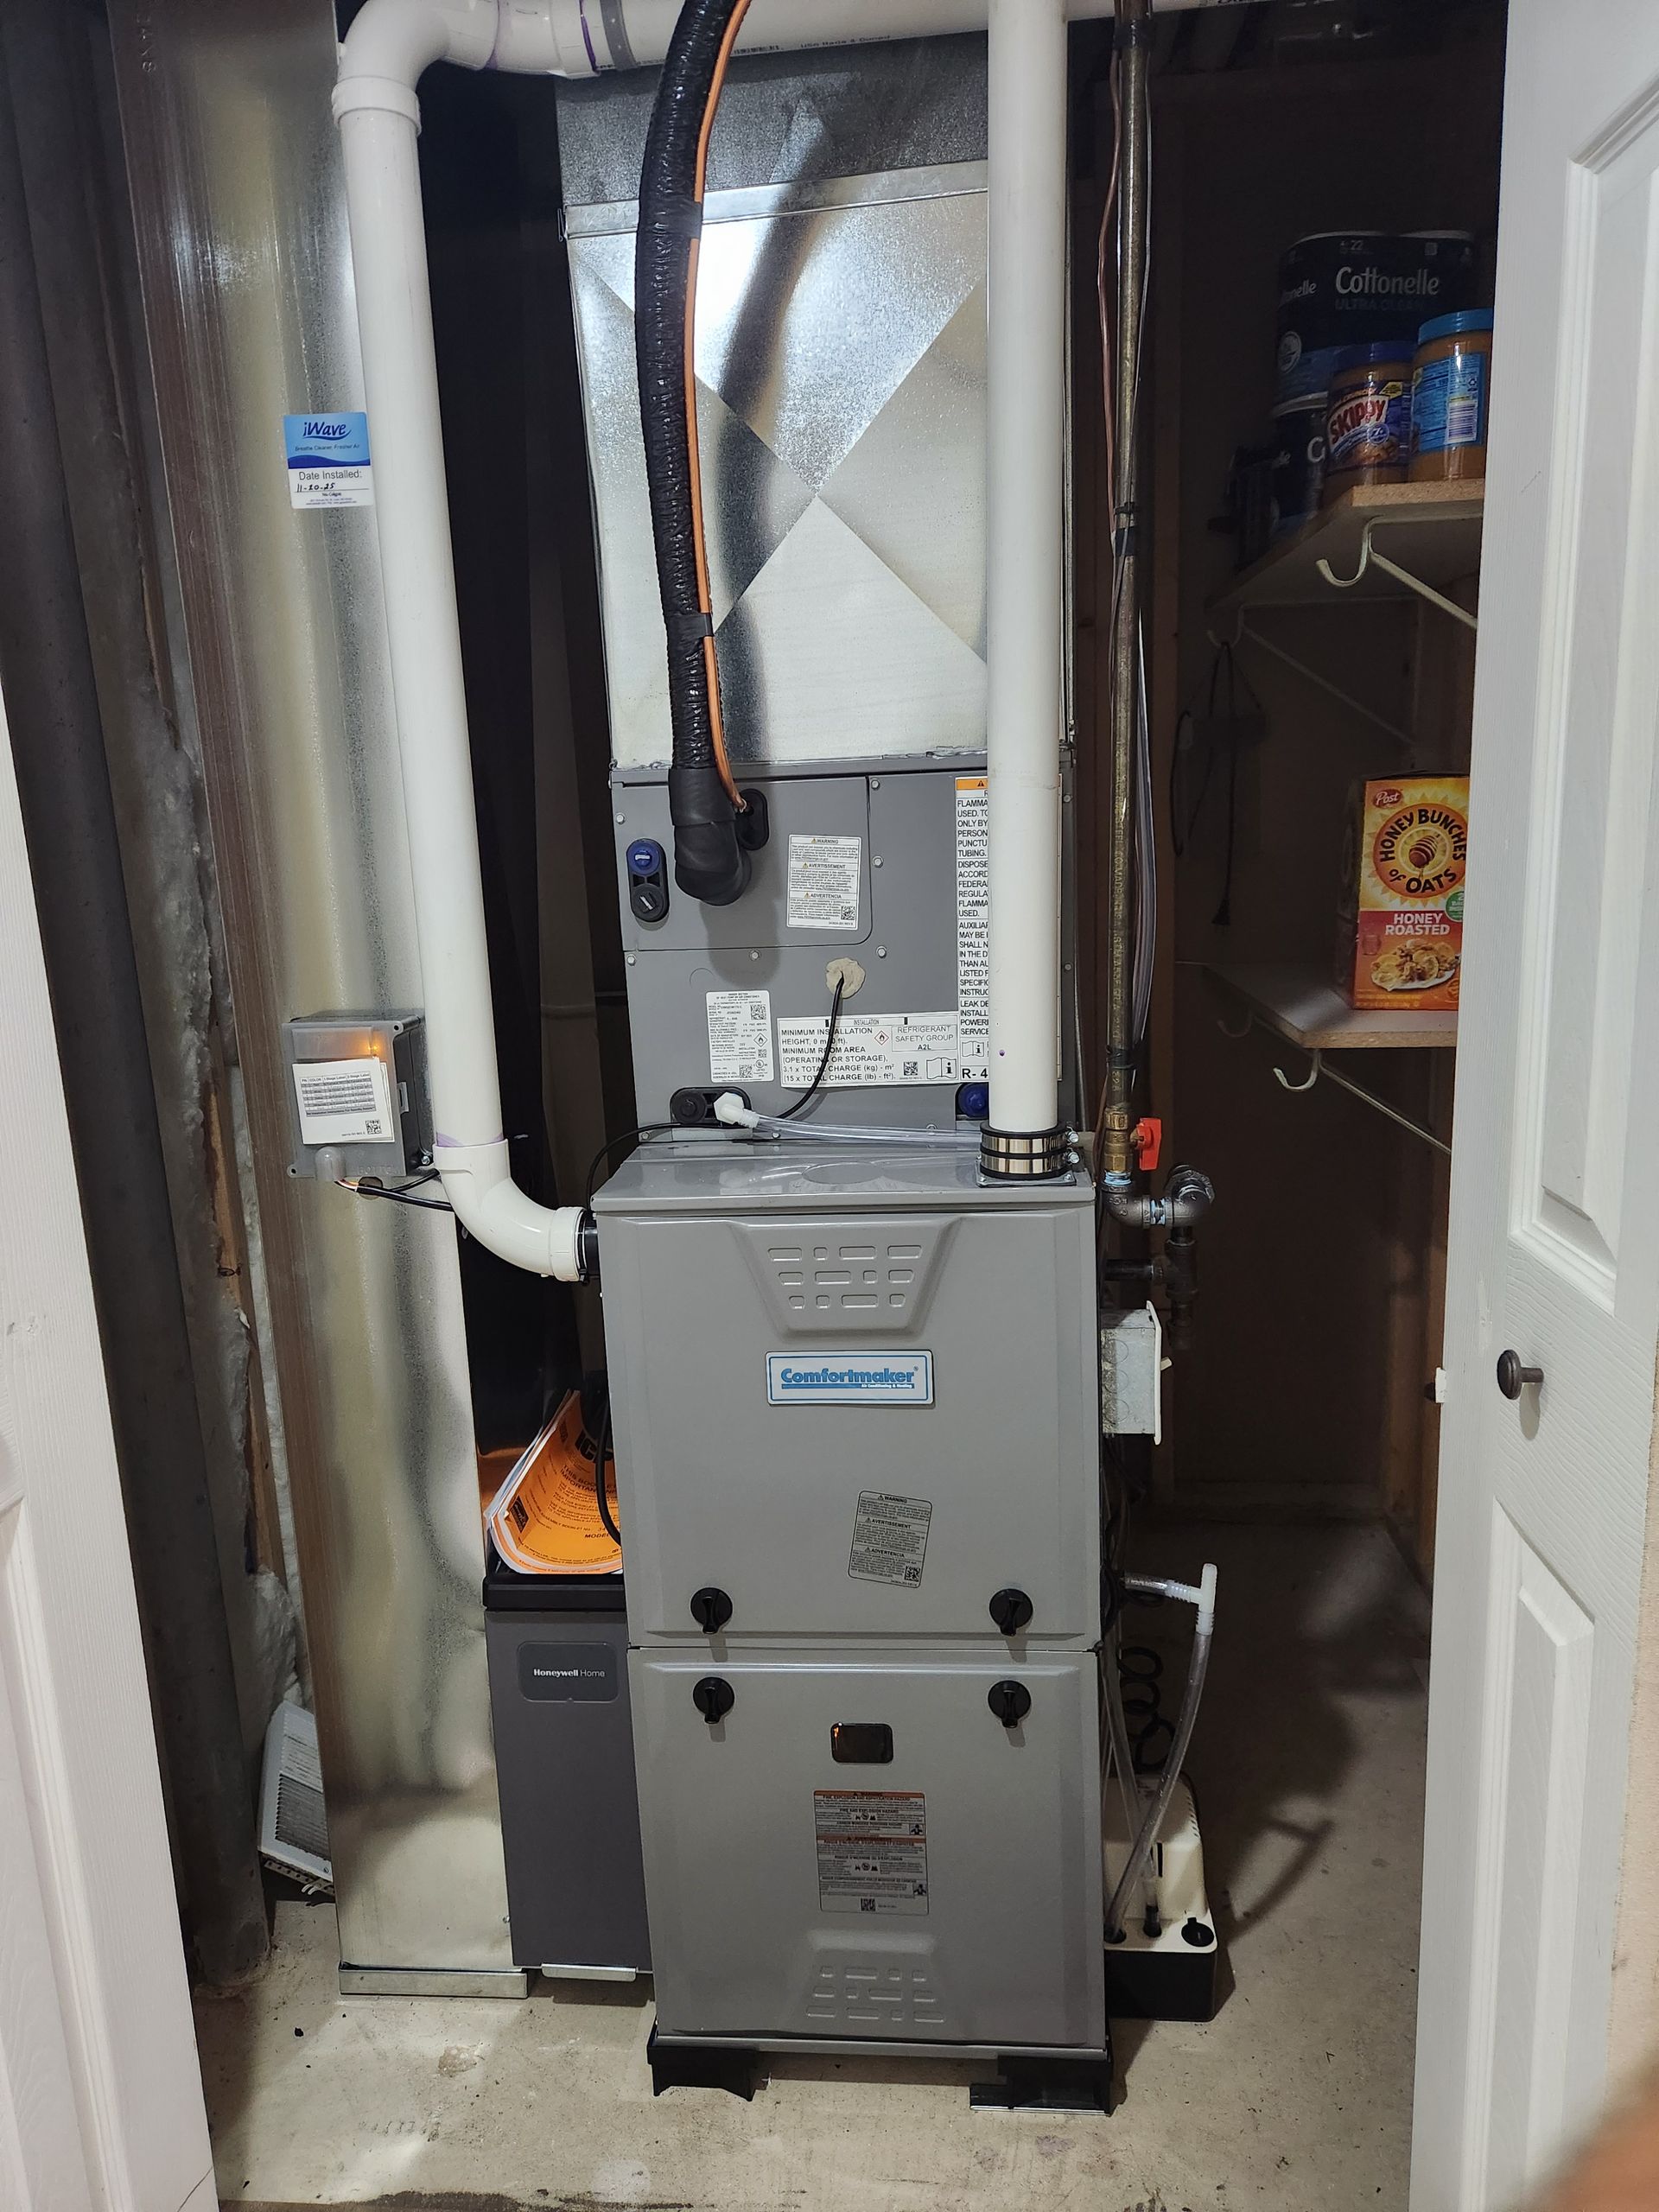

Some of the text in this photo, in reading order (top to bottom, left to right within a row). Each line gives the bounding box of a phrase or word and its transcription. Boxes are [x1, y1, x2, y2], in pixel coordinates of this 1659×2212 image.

[1335, 266, 1440, 296] Cottonelle
[1329, 399, 1387, 445] SKIPPY
[303, 422, 346, 436] iWave
[299, 469, 363, 480] Date Installed:
[957, 799, 988, 808] FLAMMA
[1376, 791, 1400, 806] Post
[957, 809, 979, 818] USED.
[957, 818, 988, 828] ONLY BY
[957, 829, 988, 837] PERSON
[1379, 808, 1467, 863] HONEY BUNCHES
[957, 839, 988, 848] PUNCTU
[957, 849, 987, 857] TUBING.
[958, 870, 988, 879] ACCORD
[958, 880, 988, 888] FEDERA
[1389, 867, 1457, 893] of OATS
[1393, 912, 1443, 925] HONEY
[975, 931, 985, 939] BE
[1384, 924, 1451, 936] ROASTED
[959, 940, 982, 949] SHALL
[864, 1072, 877, 1081] (lb)
[980, 1067, 988, 1078] 4
[780, 1368, 915, 1383] Comfortmaker
[560, 1468, 596, 1493] IMPORTAN
[872, 1518, 912, 1529] AVERTISSEMENT
[871, 1548, 906, 1558] ADVERTENCIA
[533, 1669, 579, 1678] Honeywell
